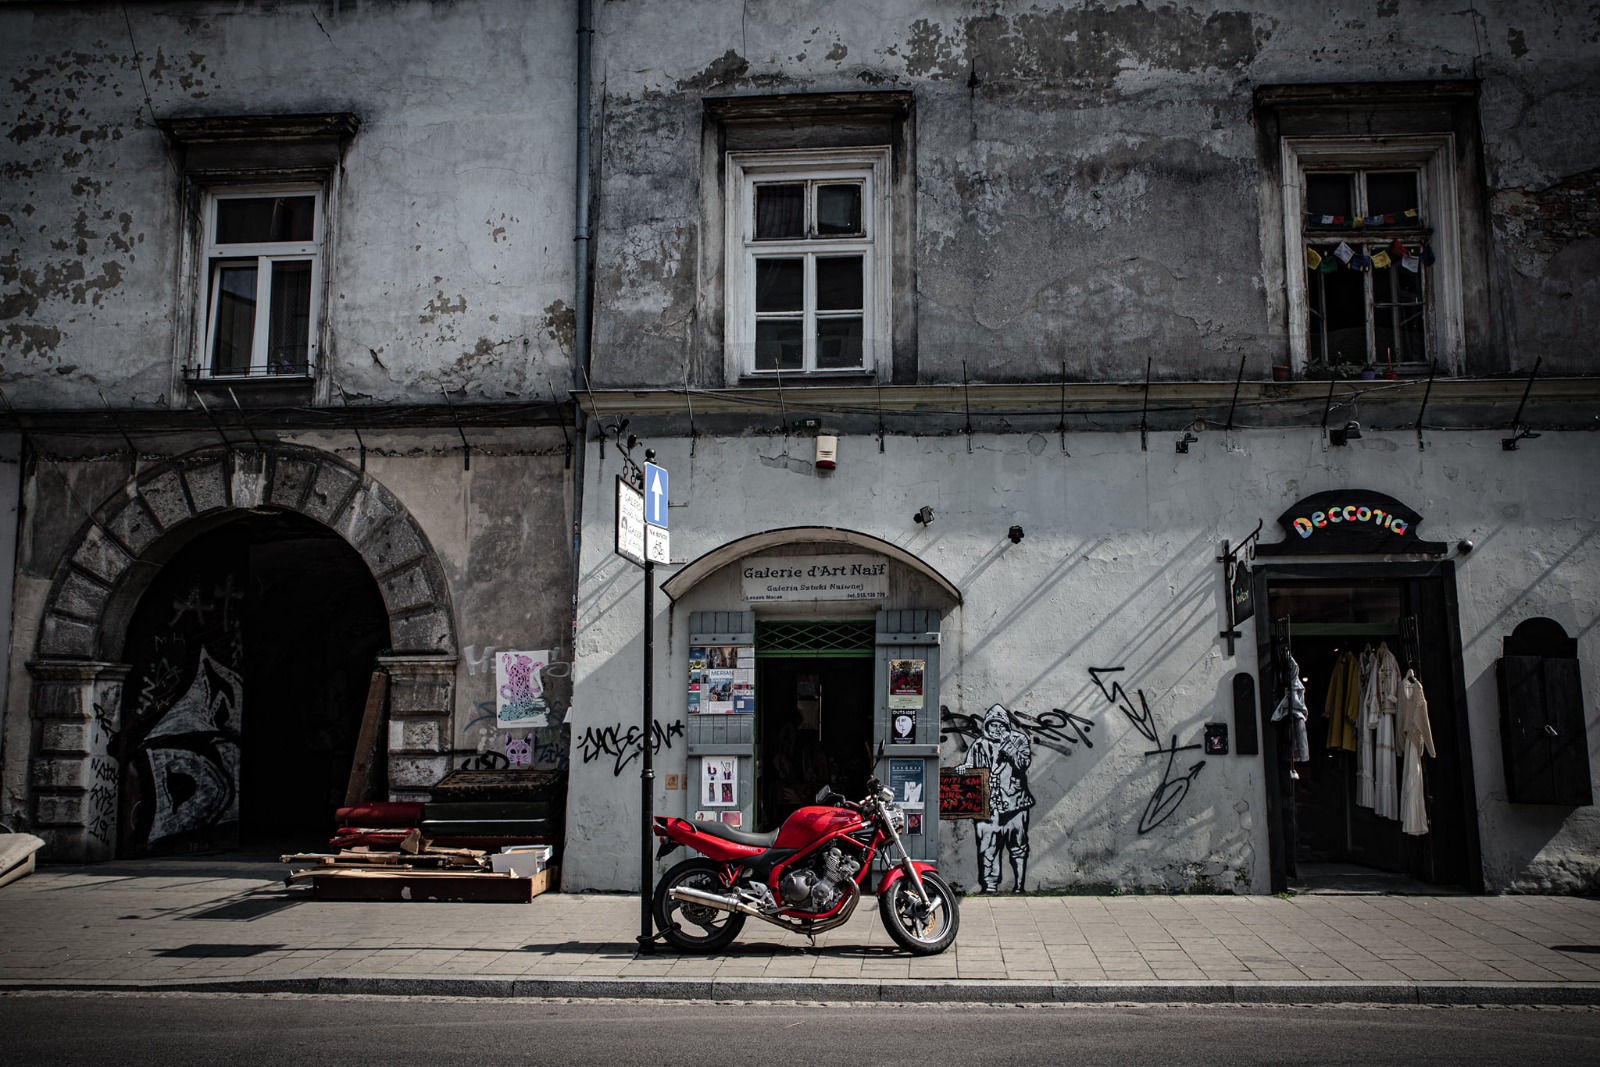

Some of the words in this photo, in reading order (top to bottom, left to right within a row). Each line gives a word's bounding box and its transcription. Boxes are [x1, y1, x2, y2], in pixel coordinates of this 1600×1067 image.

[744, 567, 802, 579] Galerie
[807, 565, 847, 577] d'Art
[829, 583, 864, 592] Naiwnej
